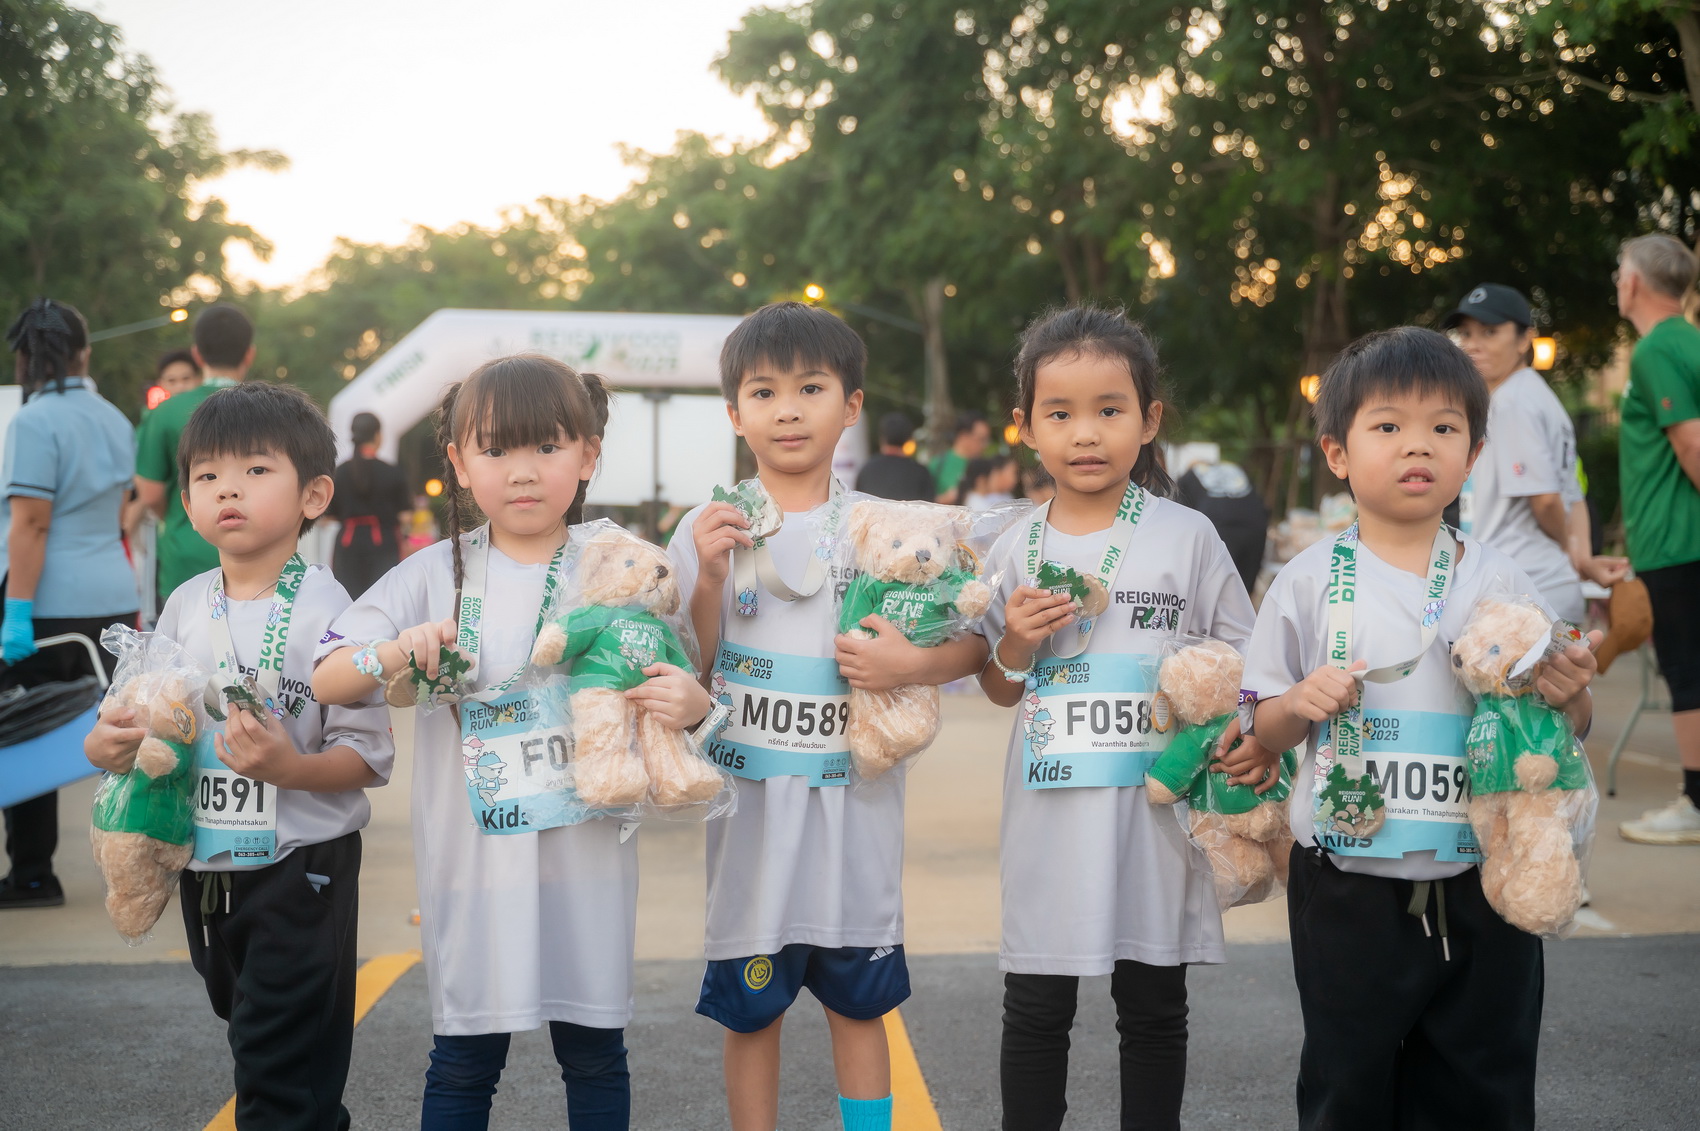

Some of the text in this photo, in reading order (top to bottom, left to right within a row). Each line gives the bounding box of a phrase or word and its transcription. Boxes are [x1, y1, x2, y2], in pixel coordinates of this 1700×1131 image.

[1027, 521, 1043, 575] Kids Run
[1100, 545, 1122, 575] Kids
[1427, 550, 1451, 599] Kids Run
[458, 596, 473, 647] EIGNWOOD
[721, 649, 774, 670] REIGNWOOD
[1331, 631, 1347, 661] Run
[749, 668, 773, 681] 2025
[1037, 673, 1090, 688] UN 2025
[291, 698, 306, 719] 2025
[469, 699, 540, 721] REIGNWOOD
[741, 693, 850, 737] M0589
[1066, 699, 1168, 736] F058
[1370, 729, 1400, 741] 2025
[707, 741, 747, 770] Kids
[1028, 760, 1073, 783] Kids
[1365, 759, 1471, 804] M059
[196, 775, 265, 813] 0591
[481, 804, 530, 830] Kids
